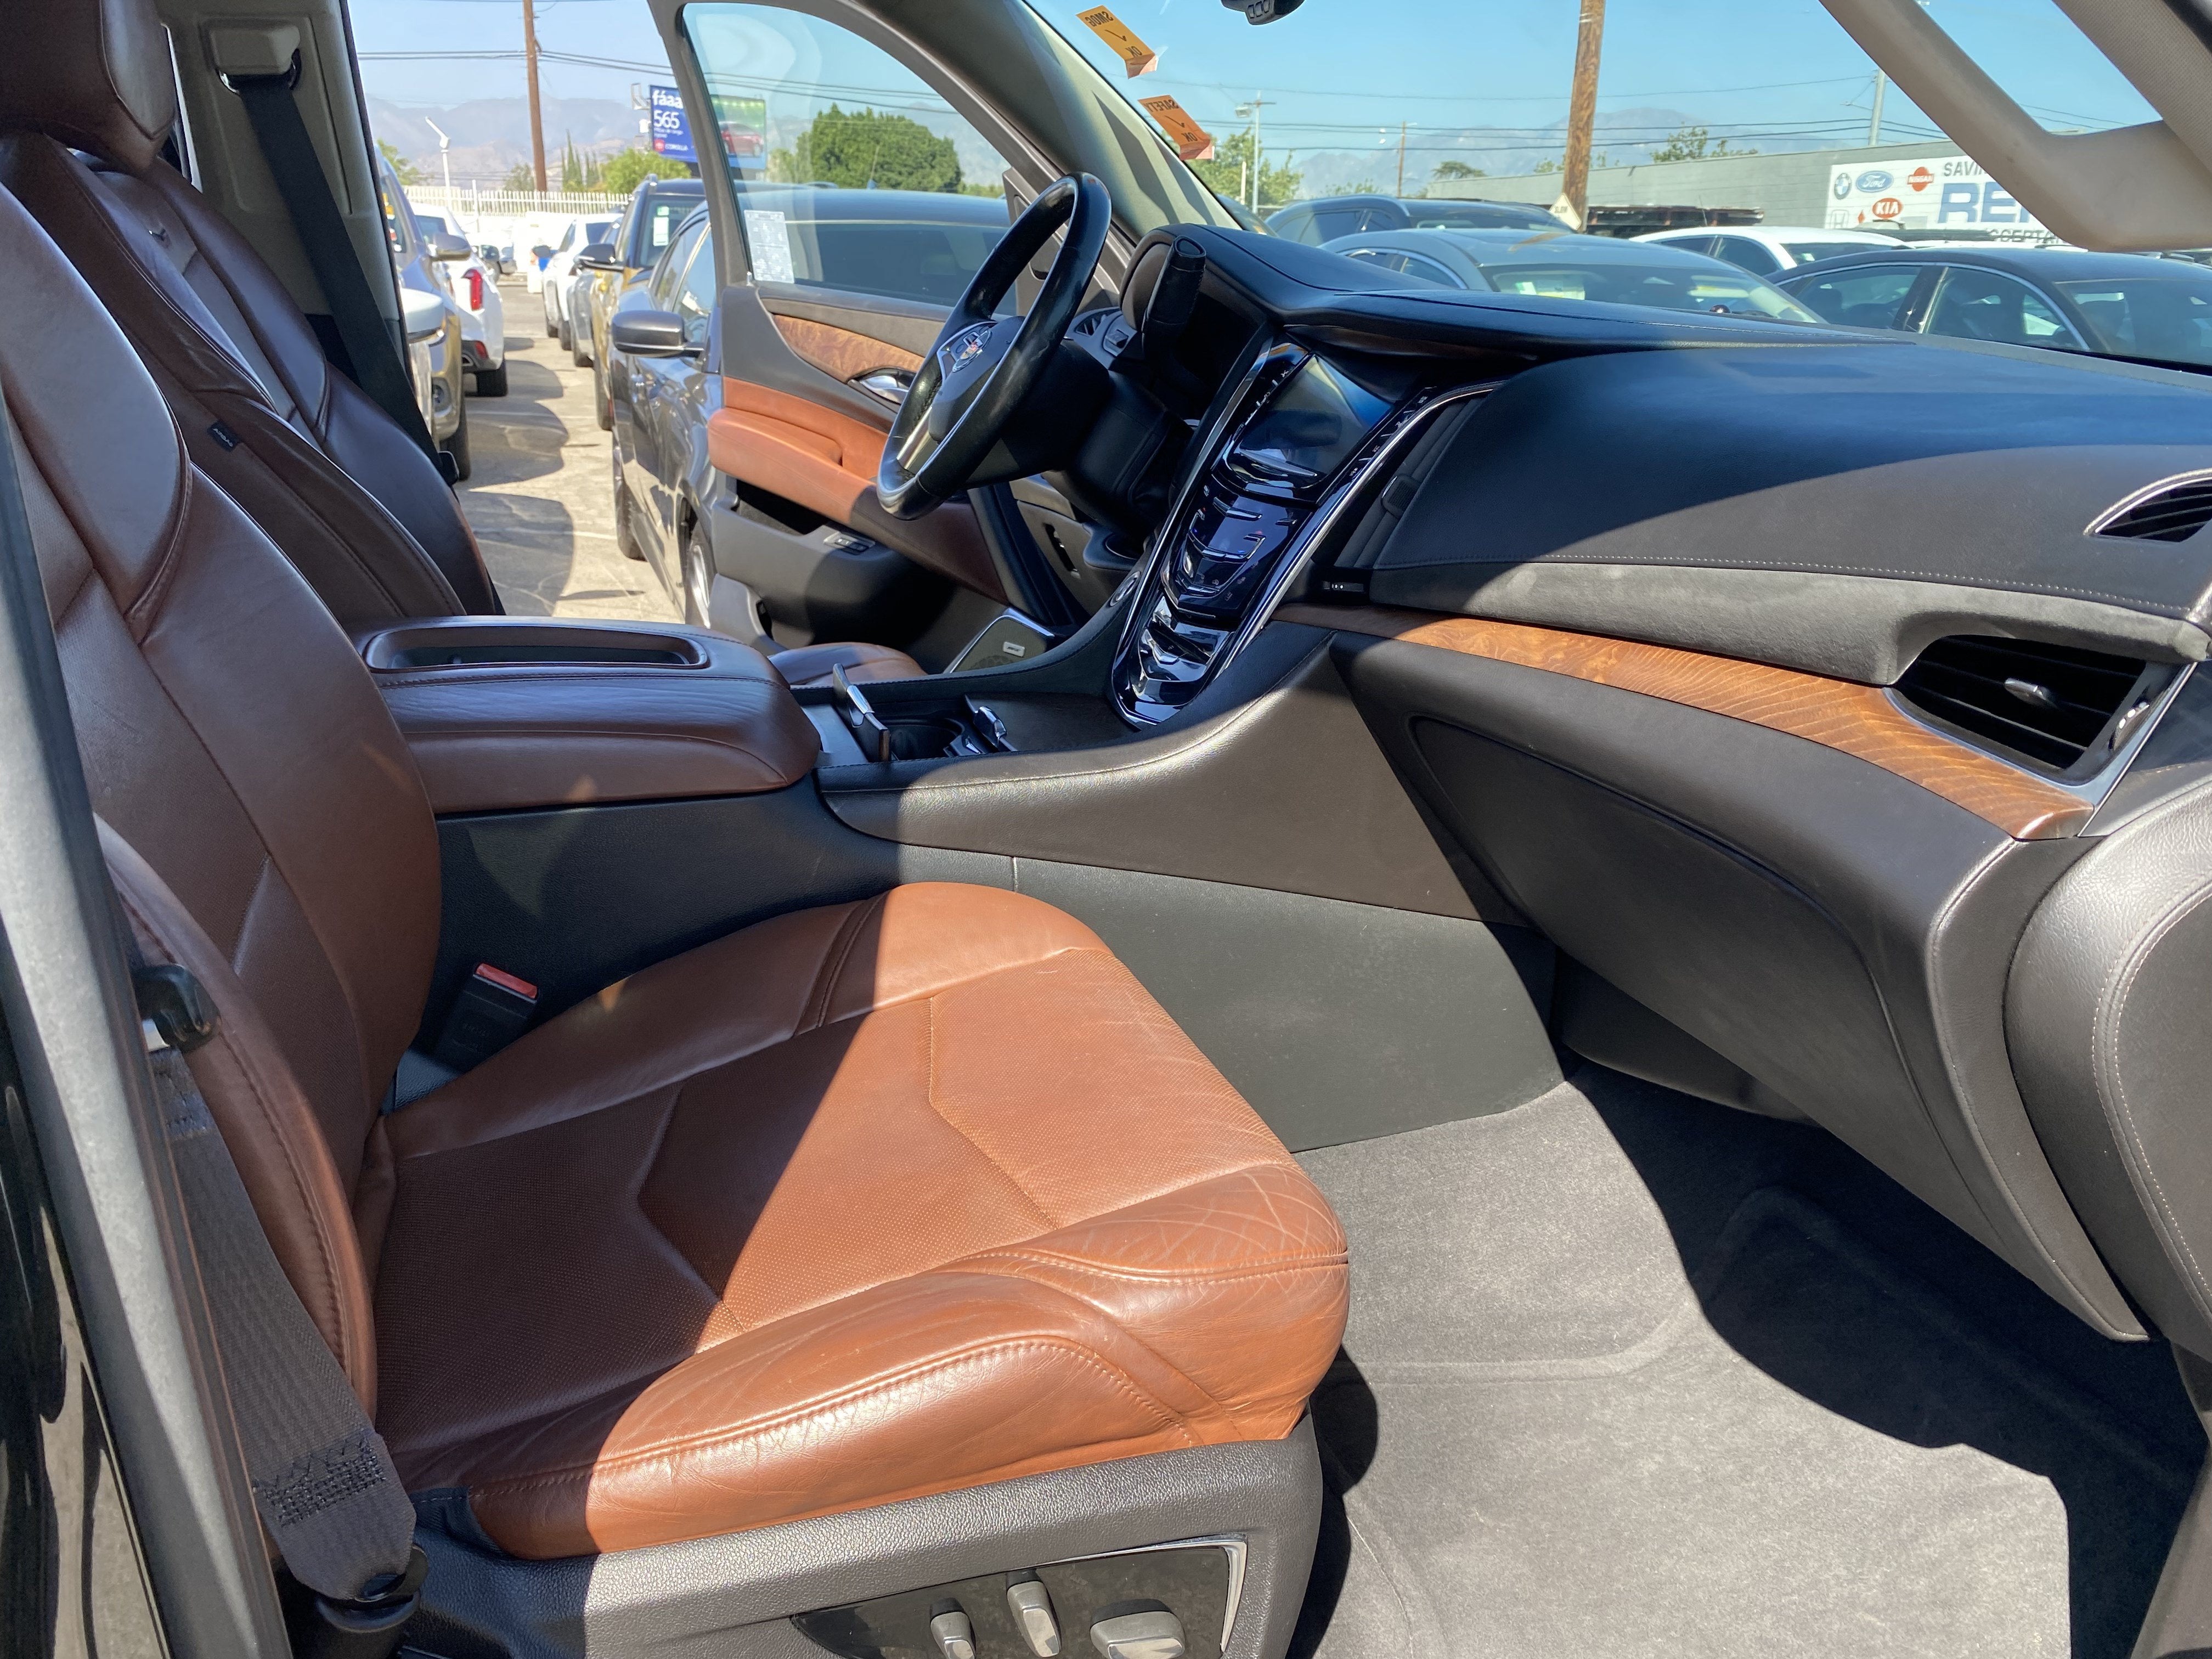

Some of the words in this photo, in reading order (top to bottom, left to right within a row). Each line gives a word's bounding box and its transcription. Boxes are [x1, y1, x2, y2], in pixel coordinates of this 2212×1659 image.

[653, 110, 680, 129] 565
[1862, 175, 1887, 188] Ford
[1908, 175, 1933, 183] NISSAN
[1875, 201, 1899, 215] KIA
